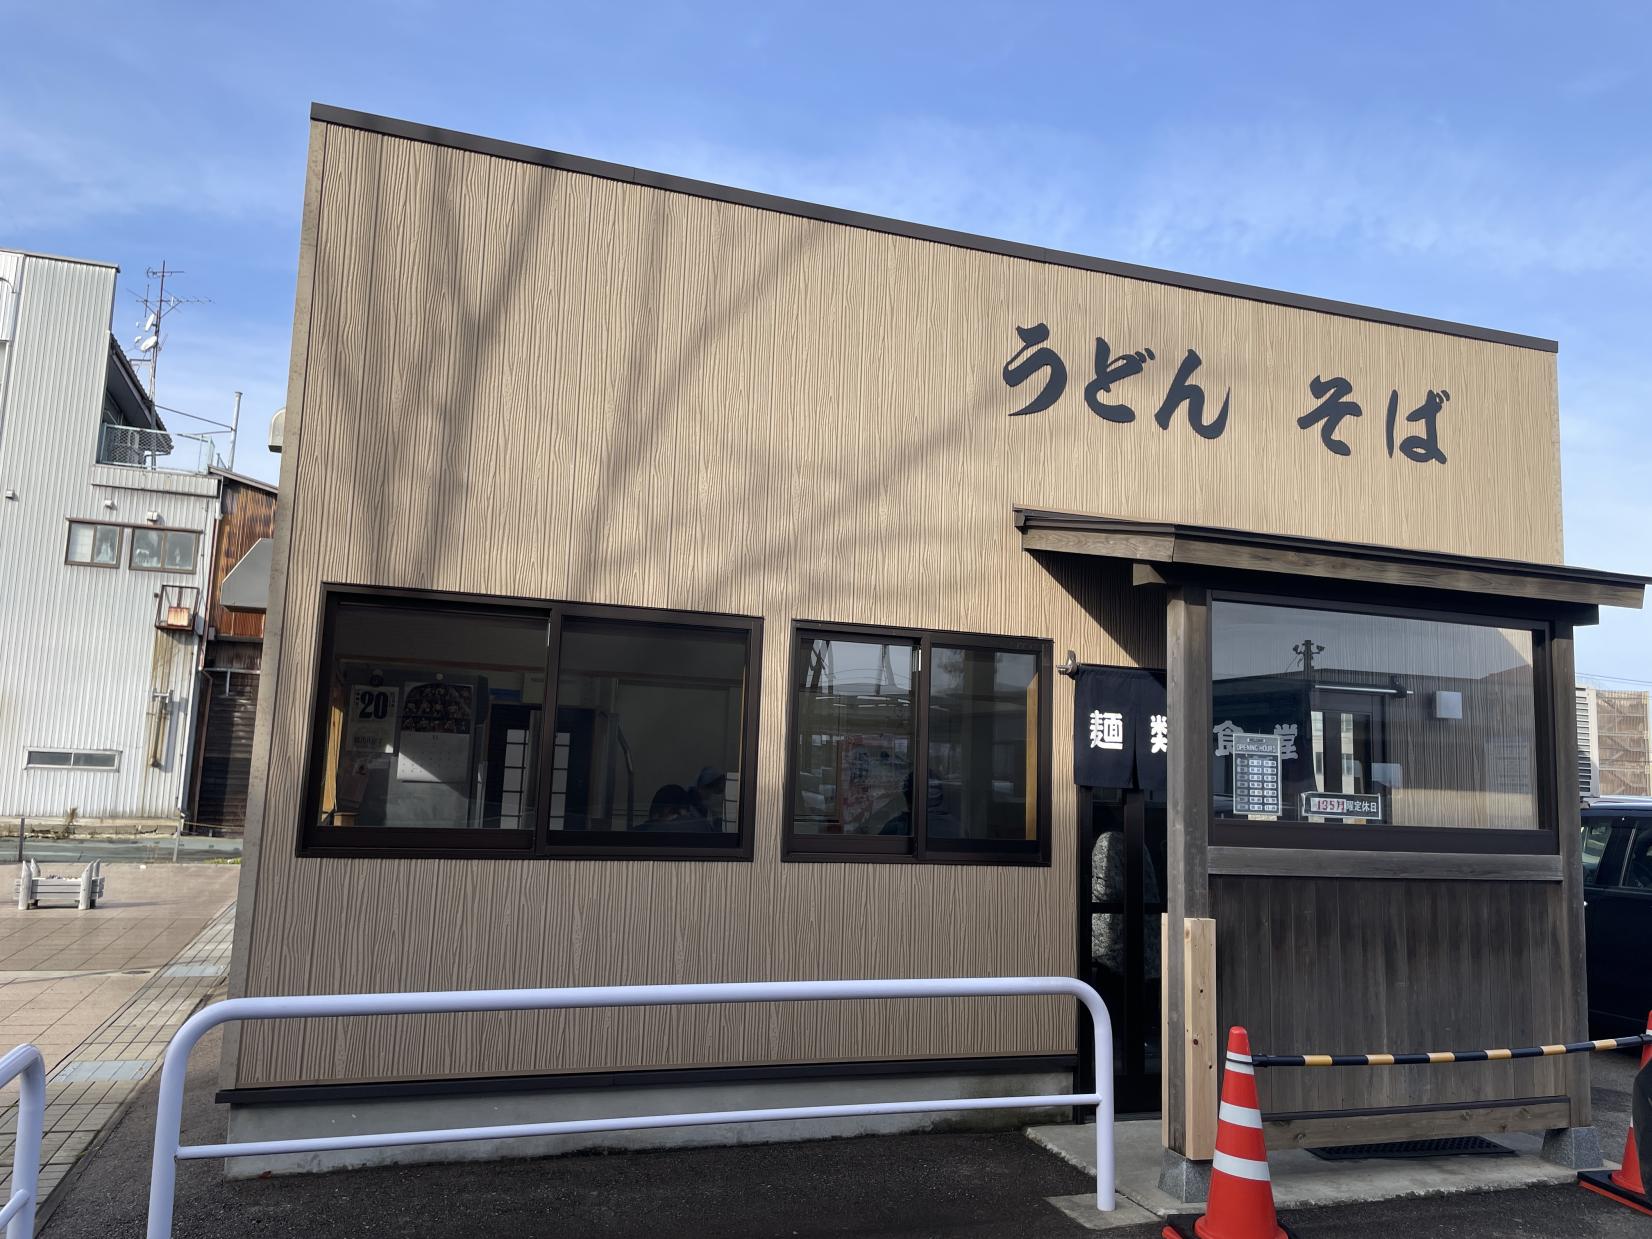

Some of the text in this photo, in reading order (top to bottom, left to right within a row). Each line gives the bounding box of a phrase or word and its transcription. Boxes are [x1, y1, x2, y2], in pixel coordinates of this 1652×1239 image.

[1003, 322, 1450, 464] うどん そば
[359, 691, 389, 719] 20
[1236, 743, 1258, 751] OPENING
